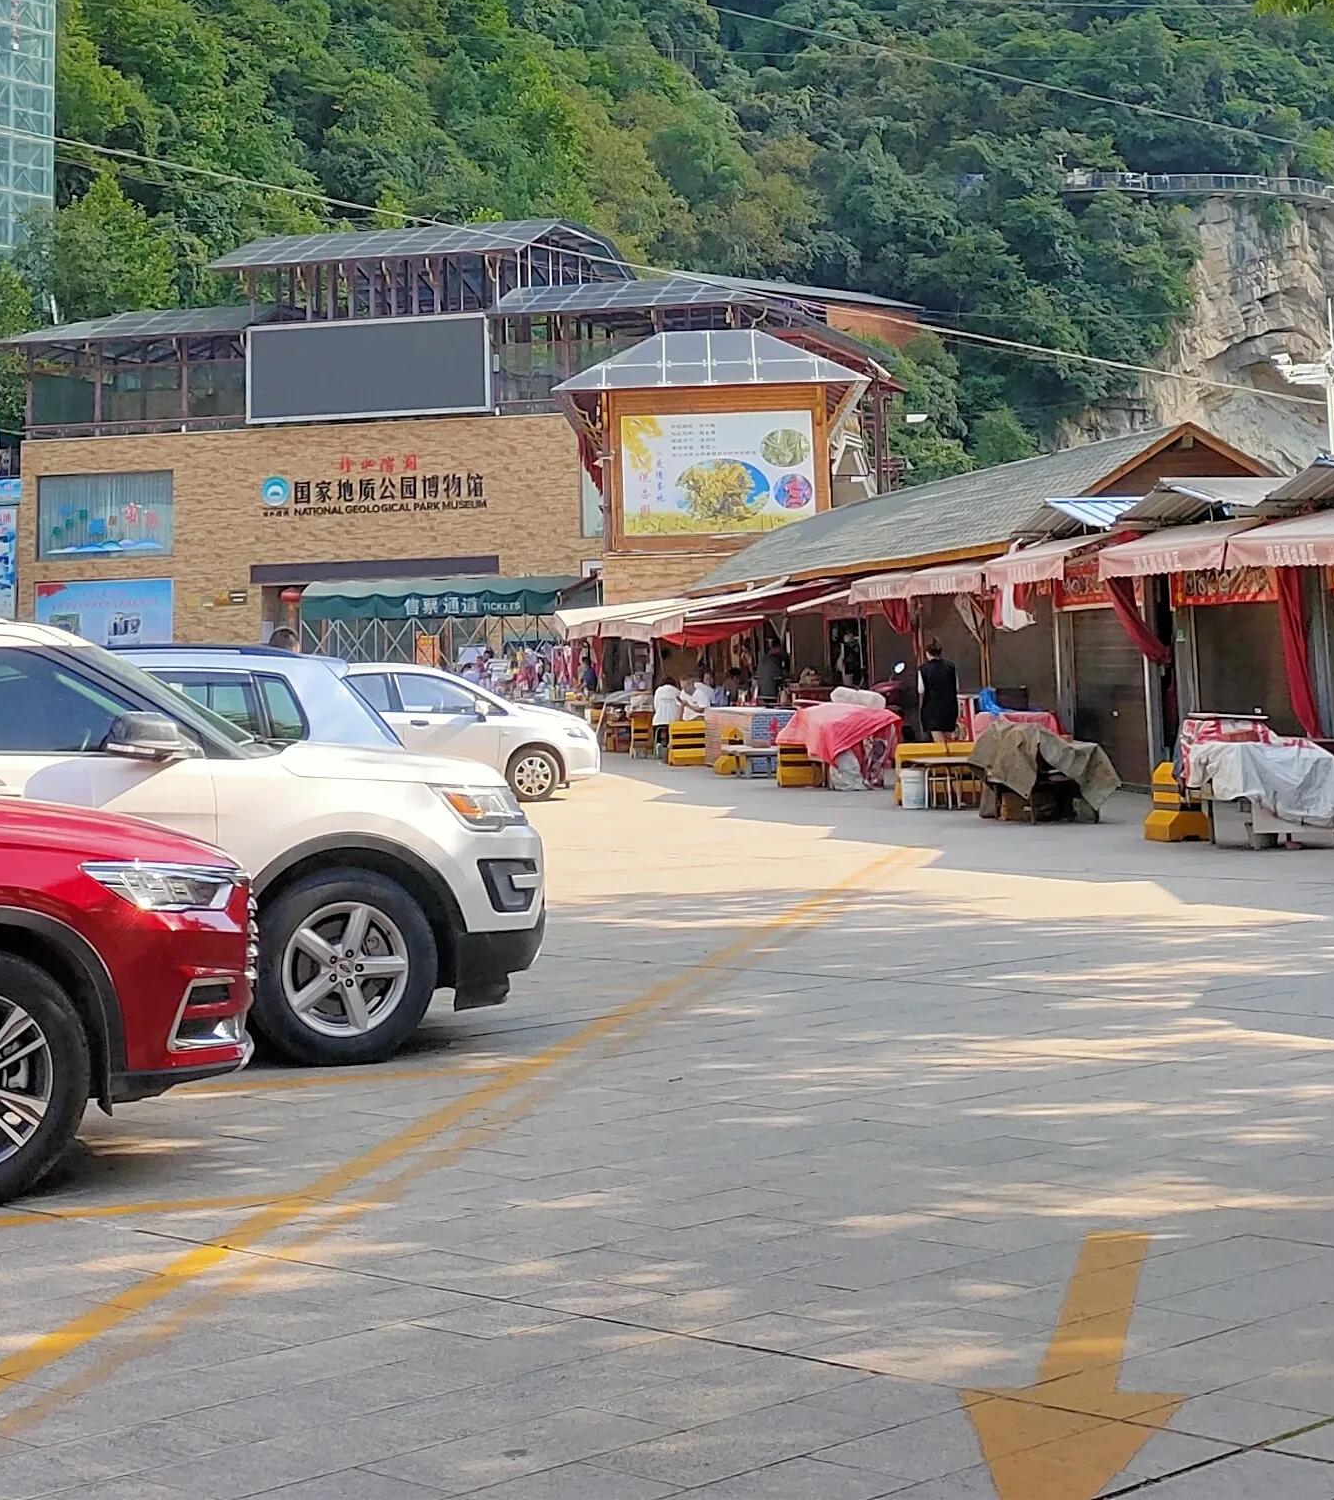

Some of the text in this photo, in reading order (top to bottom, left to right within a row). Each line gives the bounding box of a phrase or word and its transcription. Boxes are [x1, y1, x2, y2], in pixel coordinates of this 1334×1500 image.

[294, 473, 484, 504] 国家地质公园博物馆
[294, 500, 487, 516] NATIONAL GEOLOGICAL PARK MUSEUM
[405, 596, 521, 616] 售票通道 TICKETS
